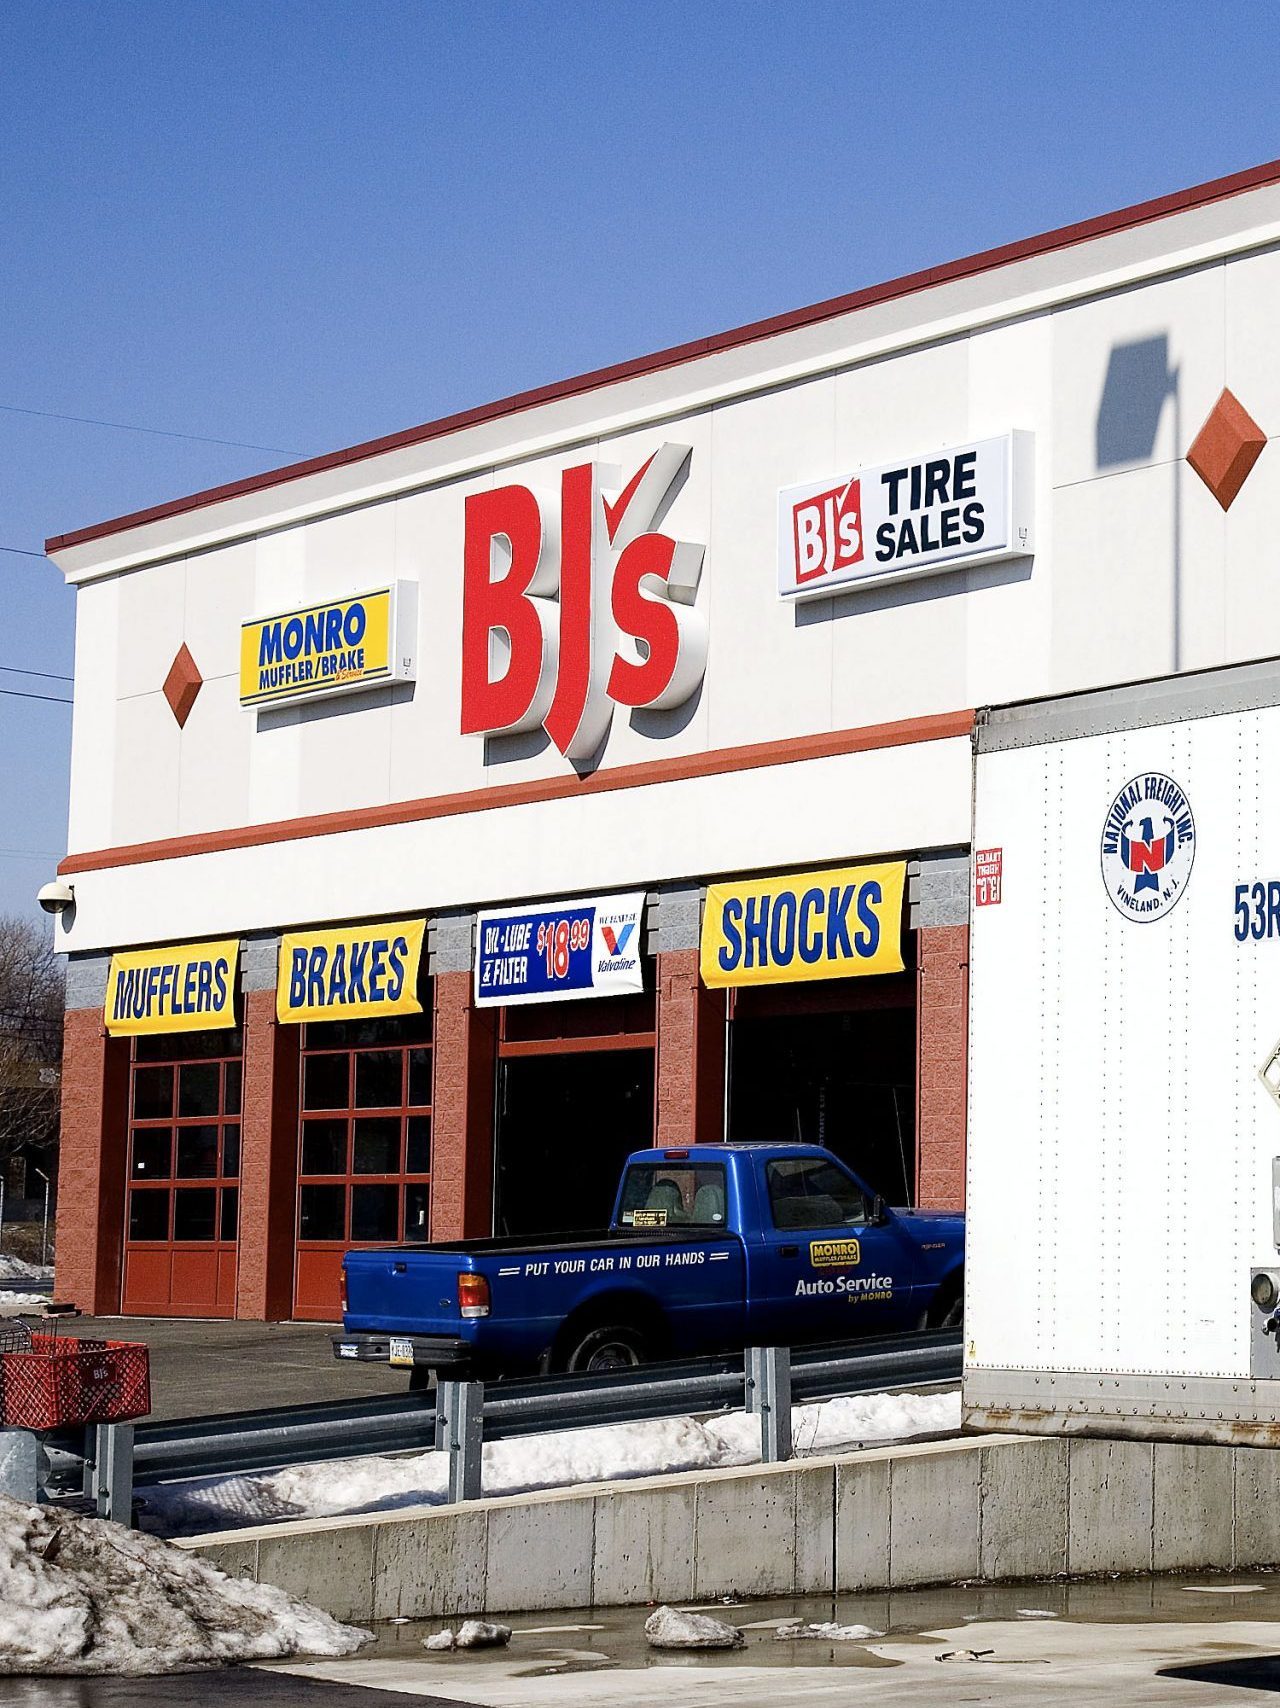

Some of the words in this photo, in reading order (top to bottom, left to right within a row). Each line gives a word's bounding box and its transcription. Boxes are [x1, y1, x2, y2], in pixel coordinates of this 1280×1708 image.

[881, 451, 977, 516] TIRE
[796, 477, 861, 575] BJ's
[875, 502, 985, 563] SALES
[460, 446, 695, 759] BJ's
[258, 603, 366, 667] MONRO
[259, 648, 365, 690] MUFFLER/BRAKE
[1103, 780, 1143, 854] NATIONAL
[1144, 776, 1186, 816] FREIGHT
[1175, 810, 1194, 850] INC.
[718, 880, 882, 972] SHOCKS
[1116, 884, 1164, 913] VINELAND,
[112, 957, 229, 1021] MUFFLERS
[289, 936, 409, 1009] BRAKES
[493, 956, 528, 986] FILTER
[598, 957, 636, 973] Valvoline
[525, 1262, 550, 1277] PUT
[554, 1260, 585, 1274] YOUR
[590, 1258, 614, 1271] CAR
[619, 1256, 631, 1269] IN
[636, 1254, 660, 1268] OUR
[665, 1251, 705, 1266] HANDS
[814, 1243, 857, 1257] MONRO
[795, 1279, 834, 1296] Auto
[836, 1272, 893, 1293] Service
[848, 1294, 859, 1304] by
[860, 1290, 893, 1301] MONRO
